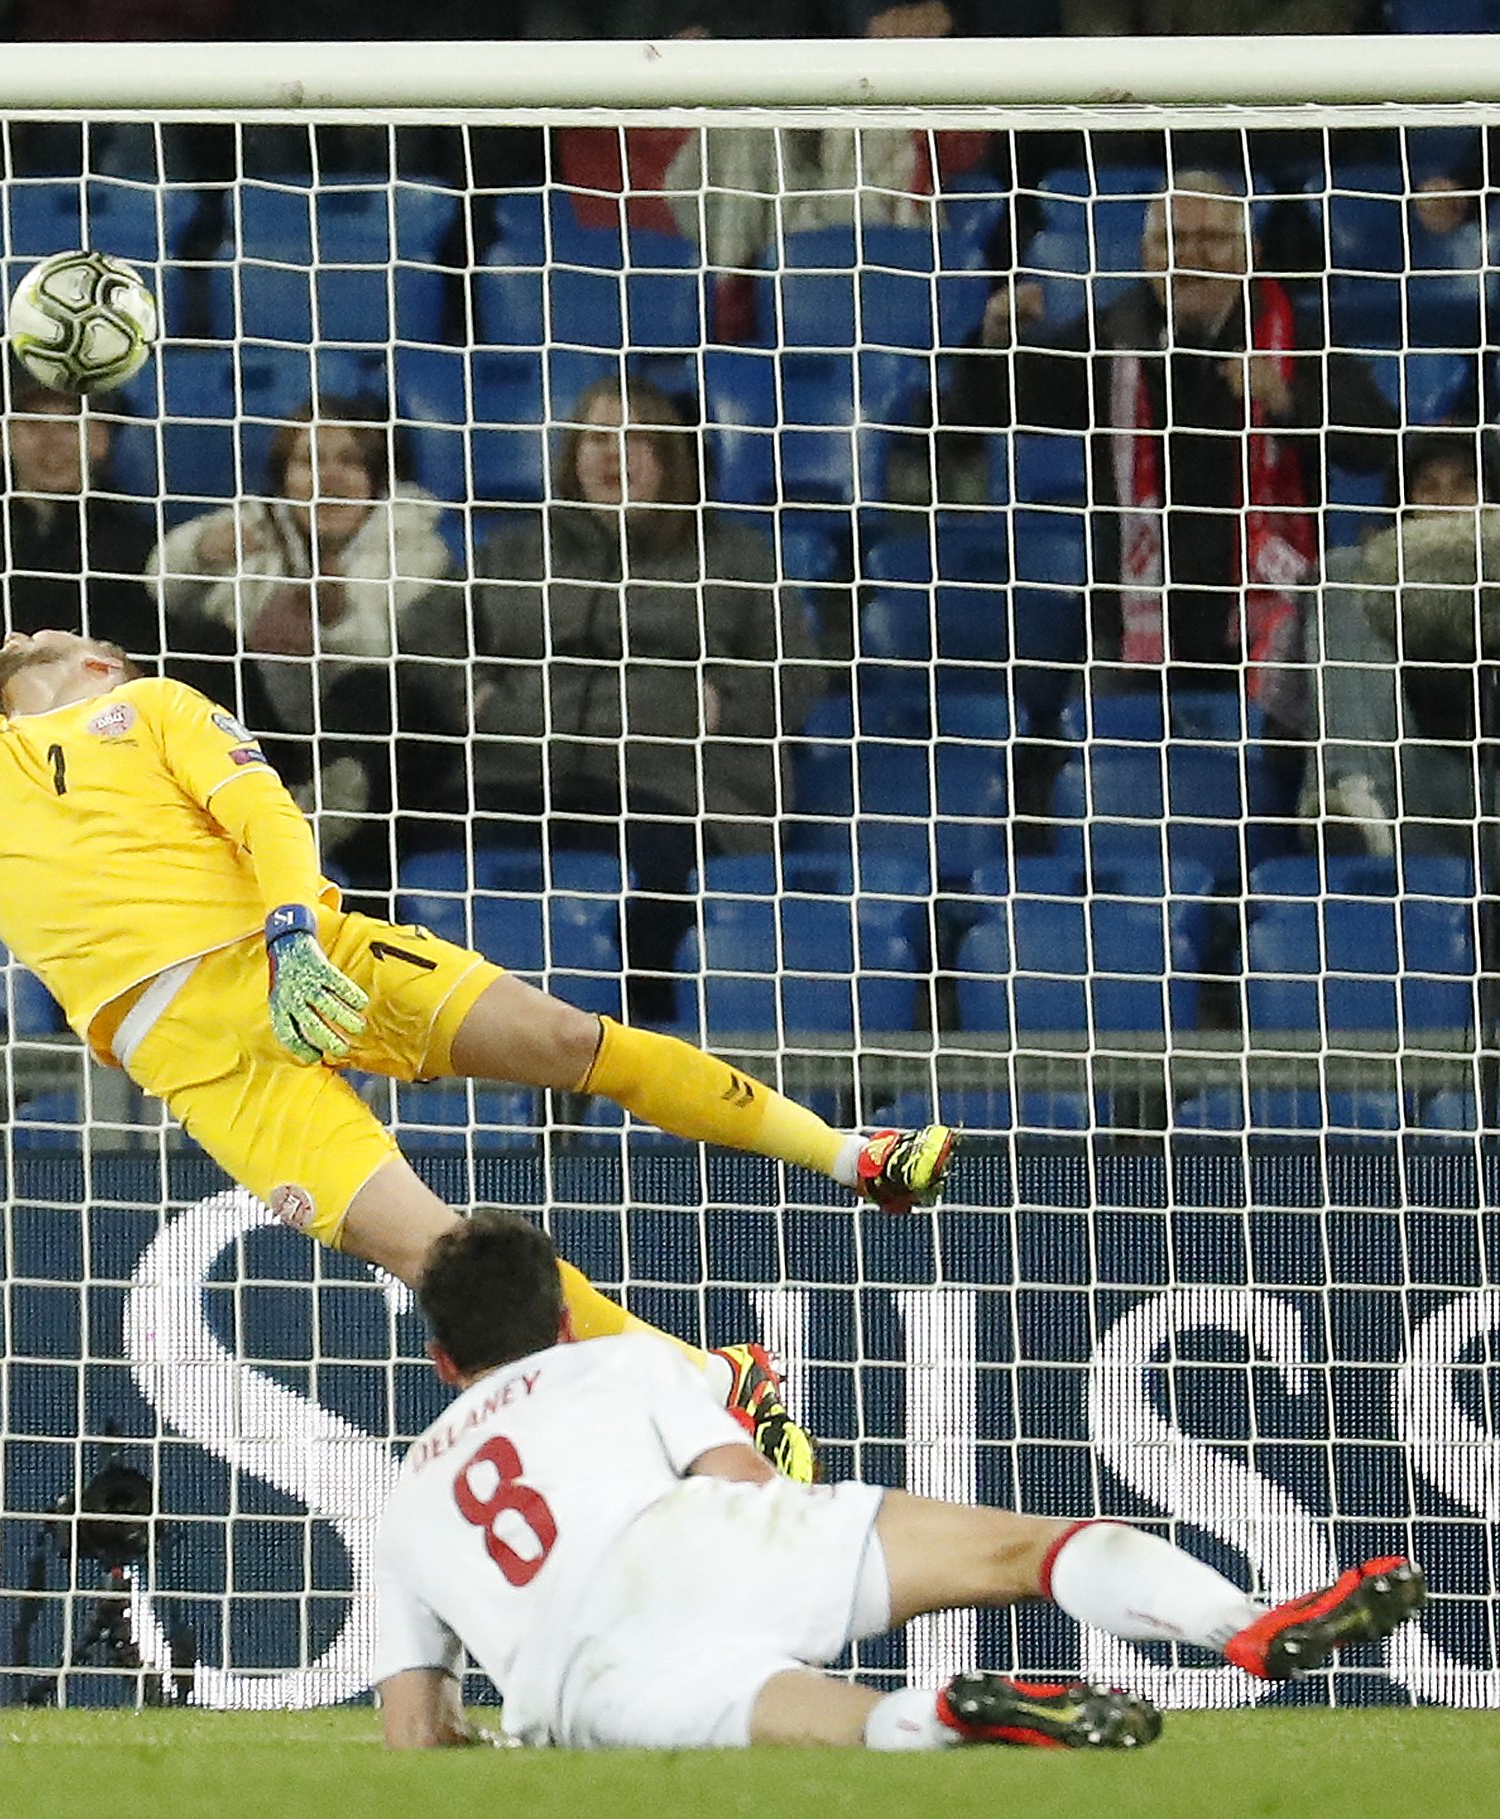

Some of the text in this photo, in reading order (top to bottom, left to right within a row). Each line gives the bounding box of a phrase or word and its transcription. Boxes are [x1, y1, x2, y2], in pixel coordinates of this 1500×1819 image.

[47, 742, 68, 796] 1
[410, 1368, 541, 1474] DELANEY
[453, 1435, 558, 1587] 8
